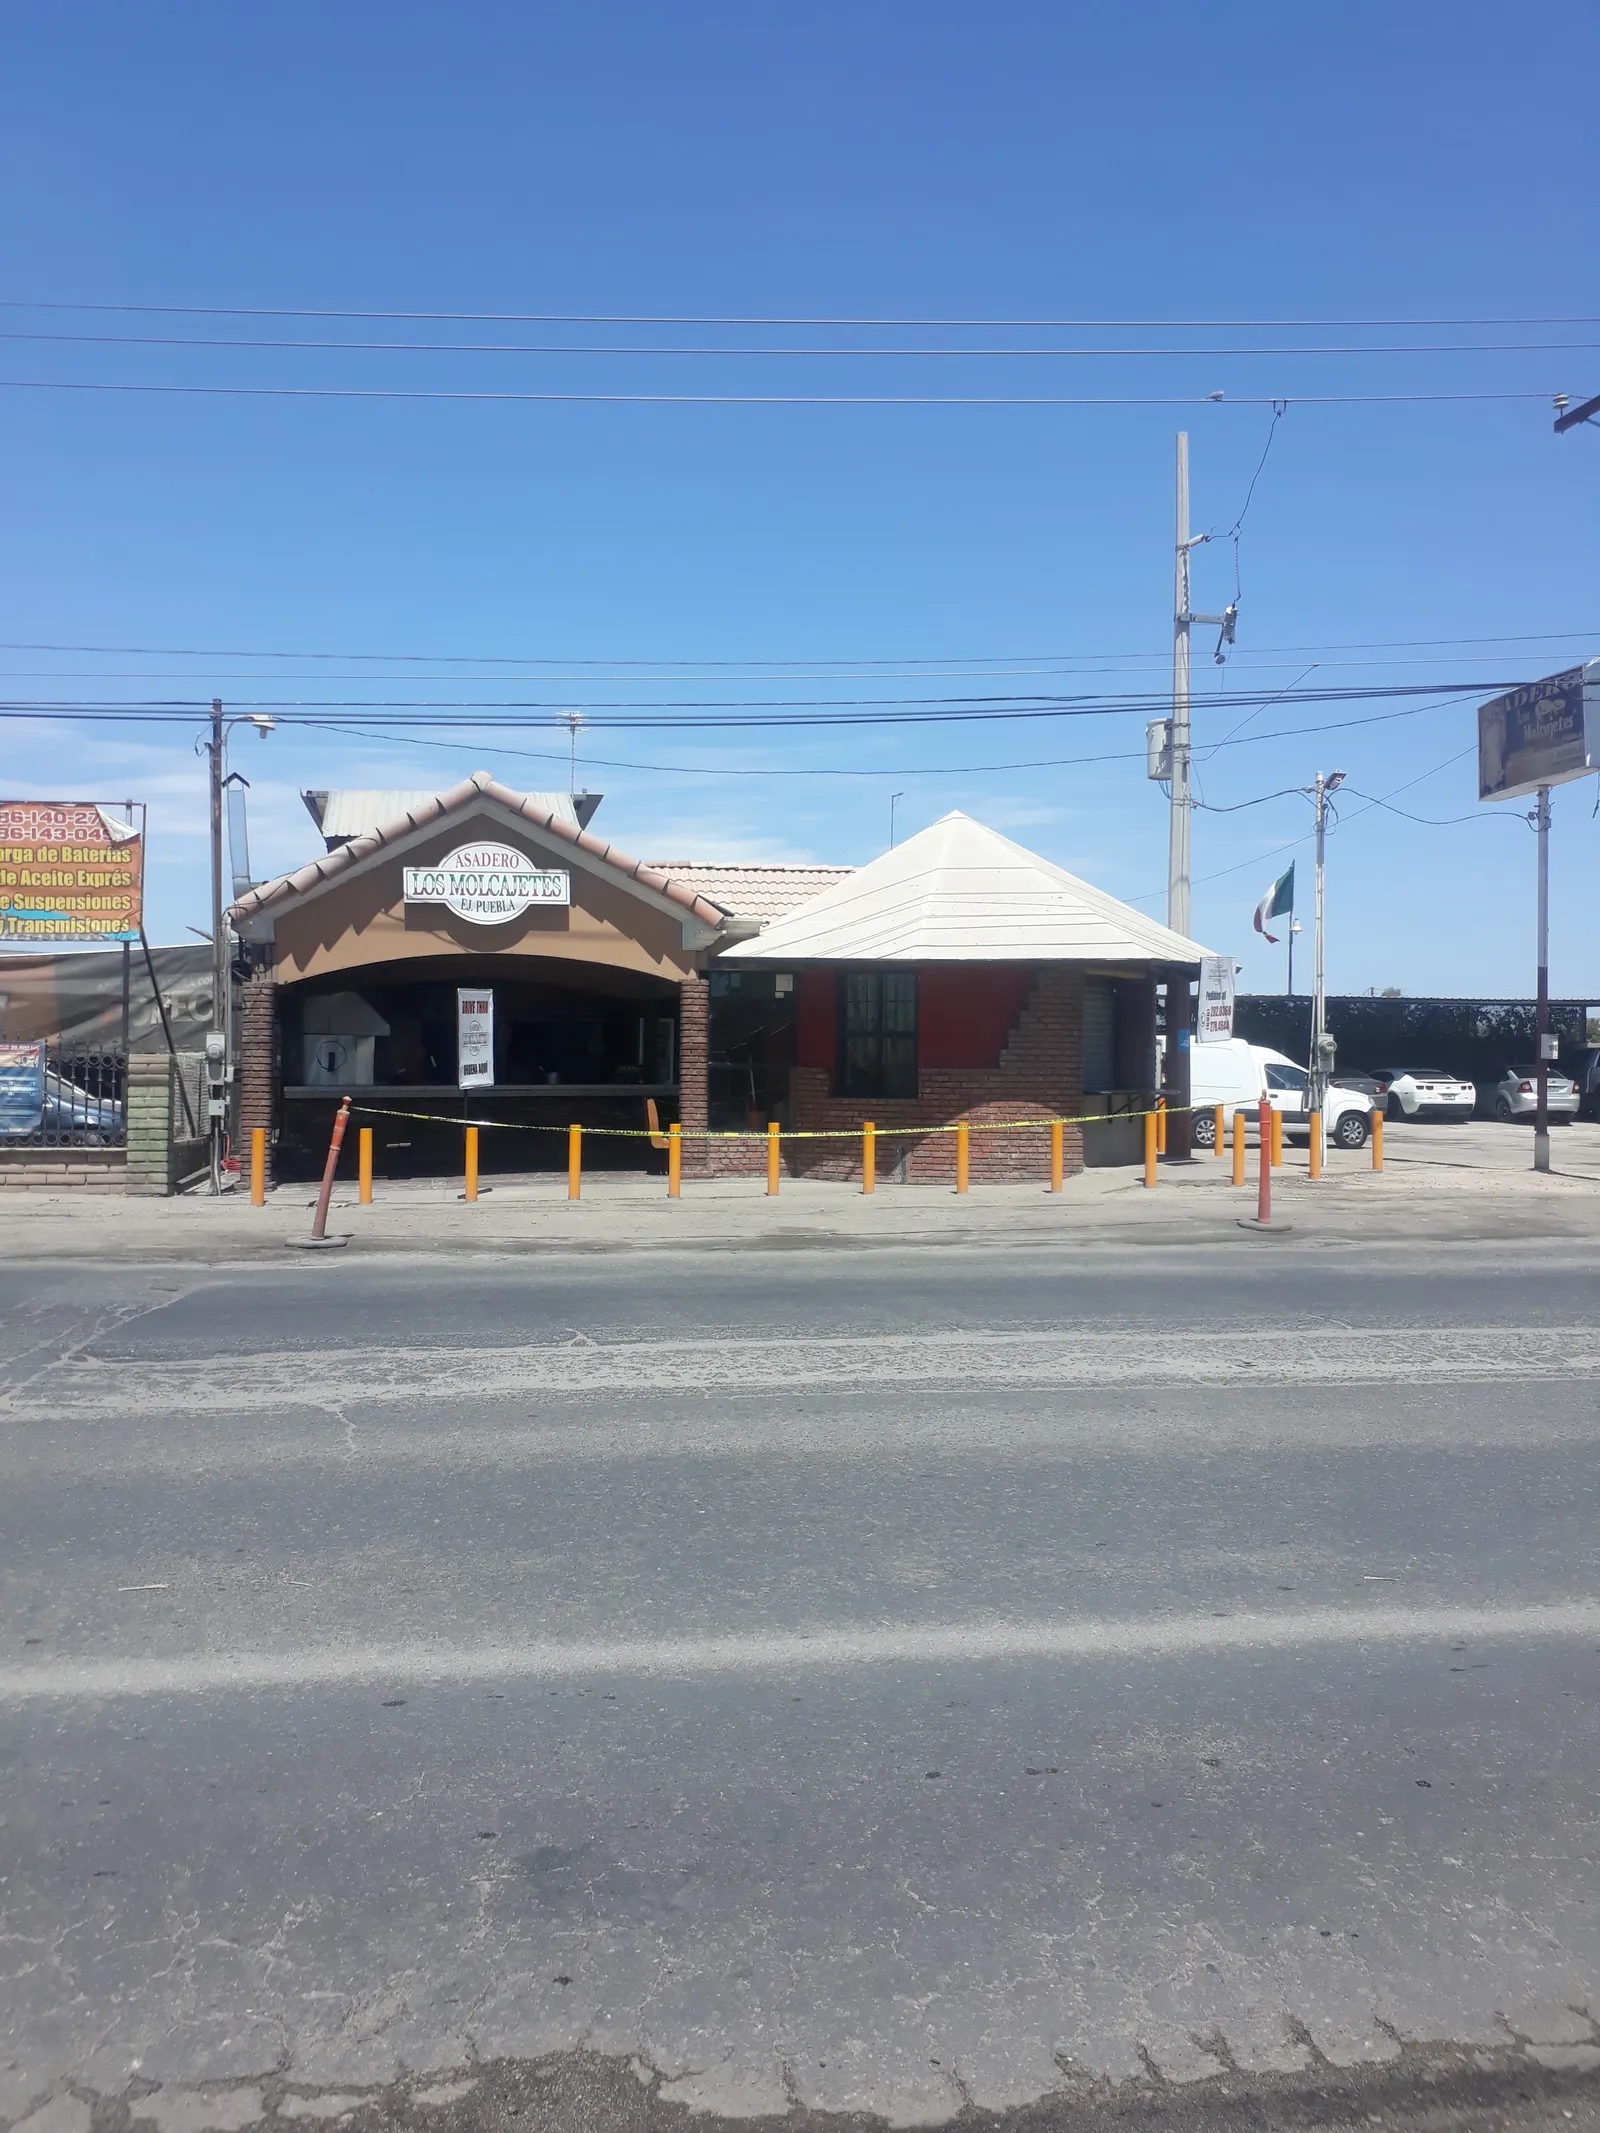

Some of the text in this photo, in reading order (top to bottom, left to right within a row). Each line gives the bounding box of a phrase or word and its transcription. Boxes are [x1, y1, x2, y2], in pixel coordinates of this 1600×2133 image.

[36, 845, 59, 864] de
[61, 845, 132, 864] Baterías
[455, 852, 520, 869] ASADERO
[19, 868, 74, 887] Aceite
[77, 868, 132, 888] Exprés
[412, 873, 562, 897] LOS MOLCAJETES
[13, 892, 132, 912] Suspensiones
[476, 899, 516, 913] PUEBLA
[7, 915, 130, 934] Transmisiones
